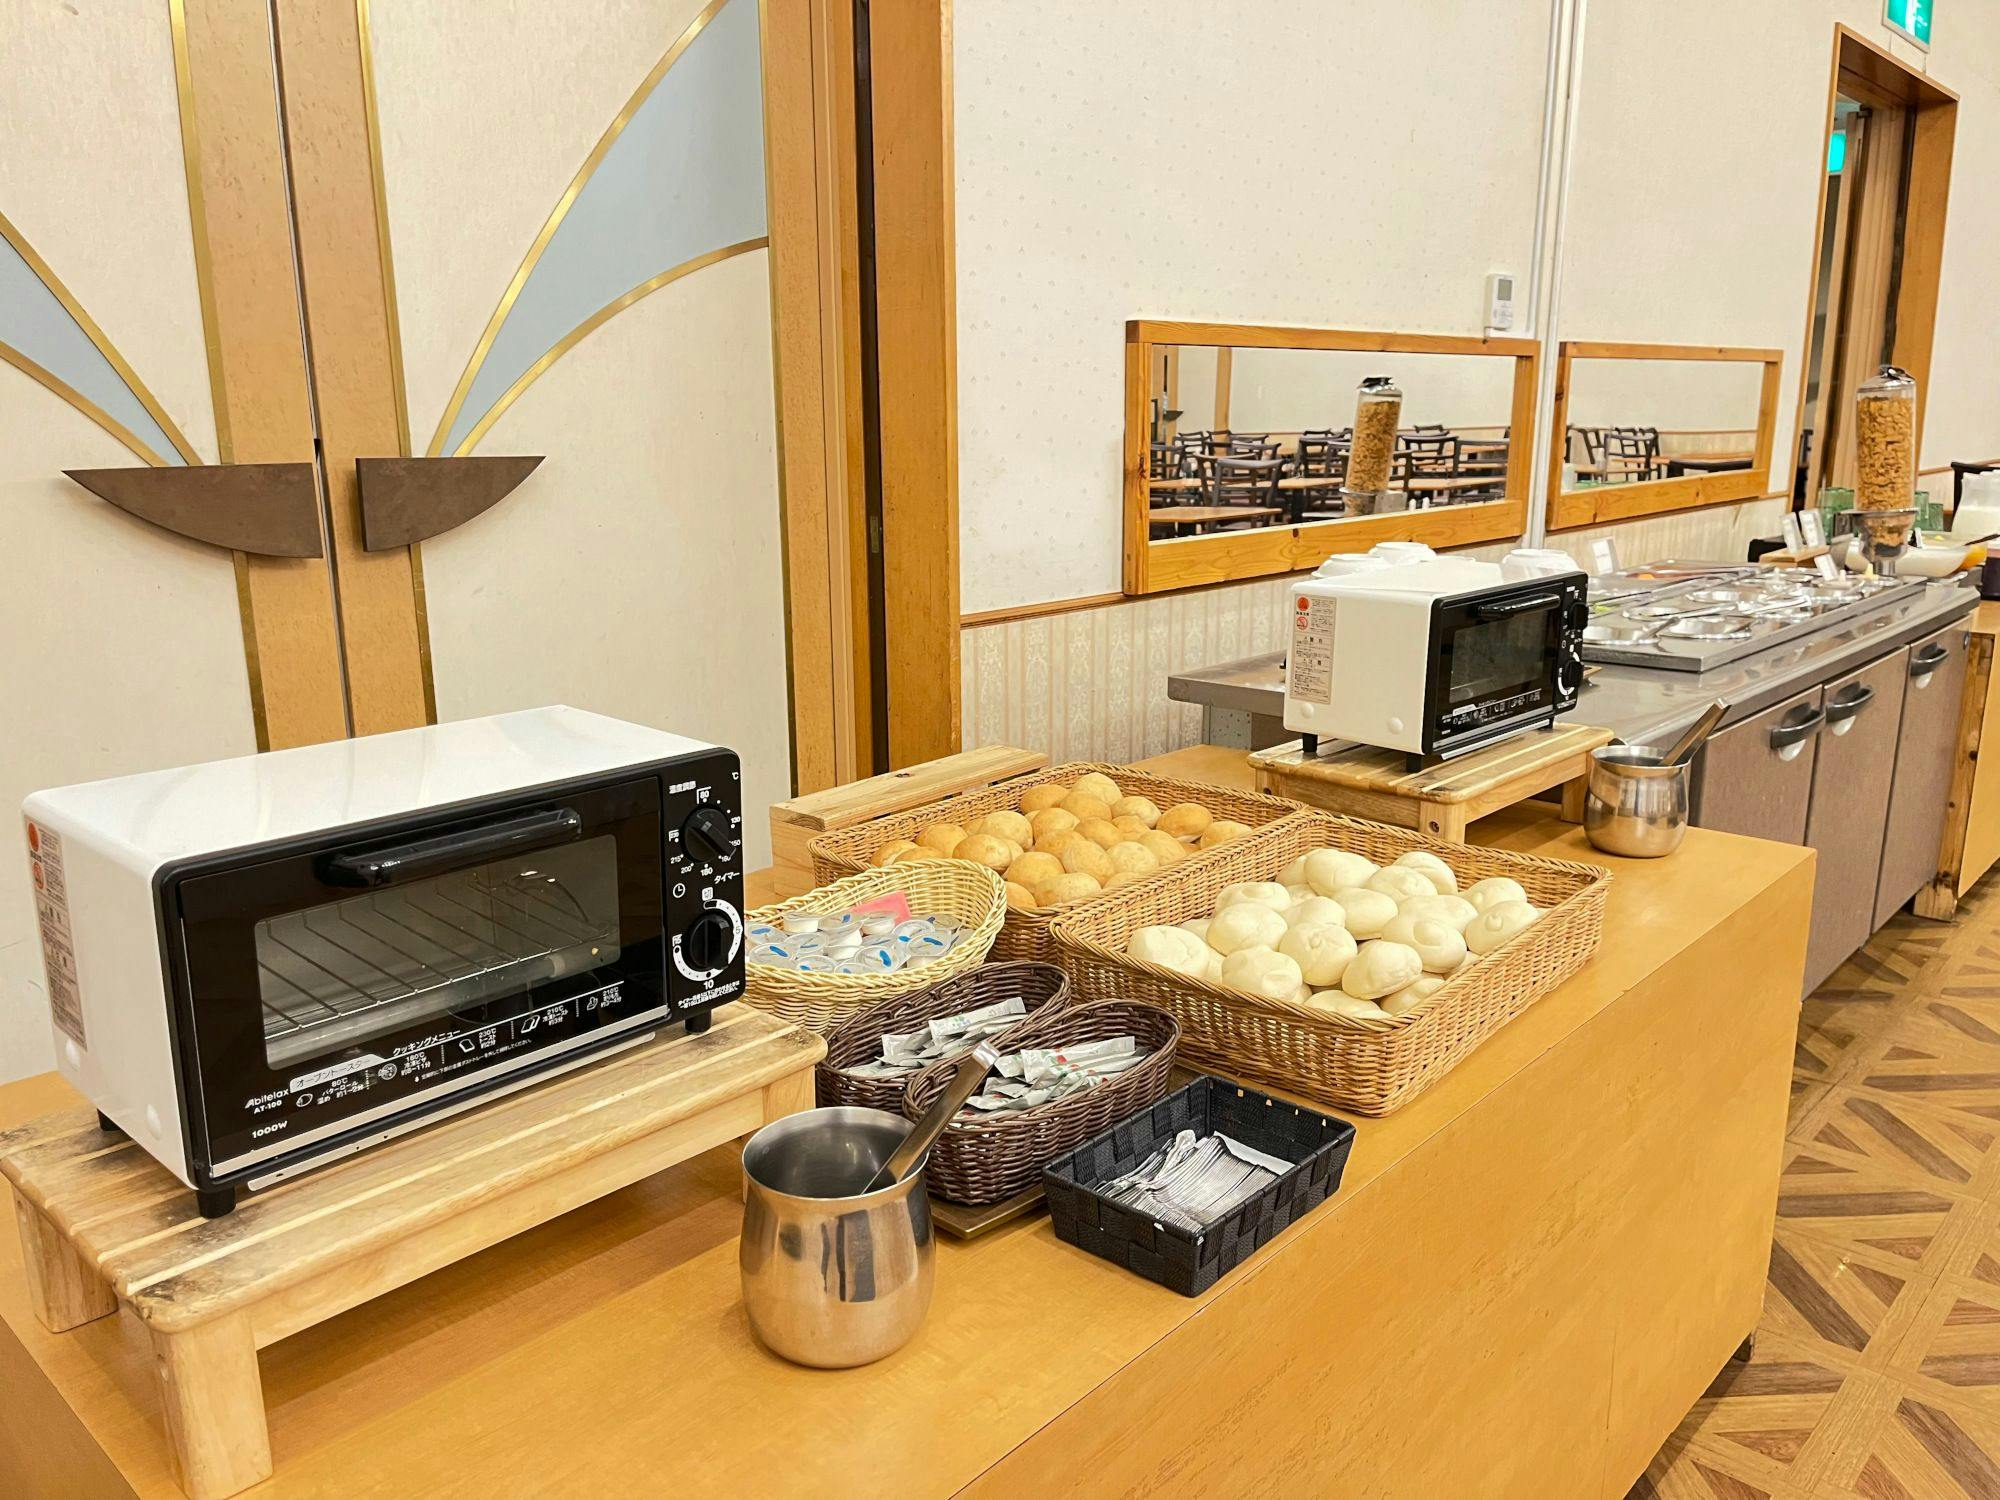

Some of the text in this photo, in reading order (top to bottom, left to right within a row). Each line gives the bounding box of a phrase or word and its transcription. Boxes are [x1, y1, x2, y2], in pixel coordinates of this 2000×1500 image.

[681, 865, 692, 875] 200
[714, 871, 740, 885] タイマー
[704, 979, 714, 990] 10
[393, 1030, 460, 1056] クッキングメニュー
[296, 1059, 371, 1088] オープントースター
[245, 1089, 289, 1109] Abitelax
[254, 1100, 283, 1114] AT-100
[252, 1120, 288, 1138] 1000W
